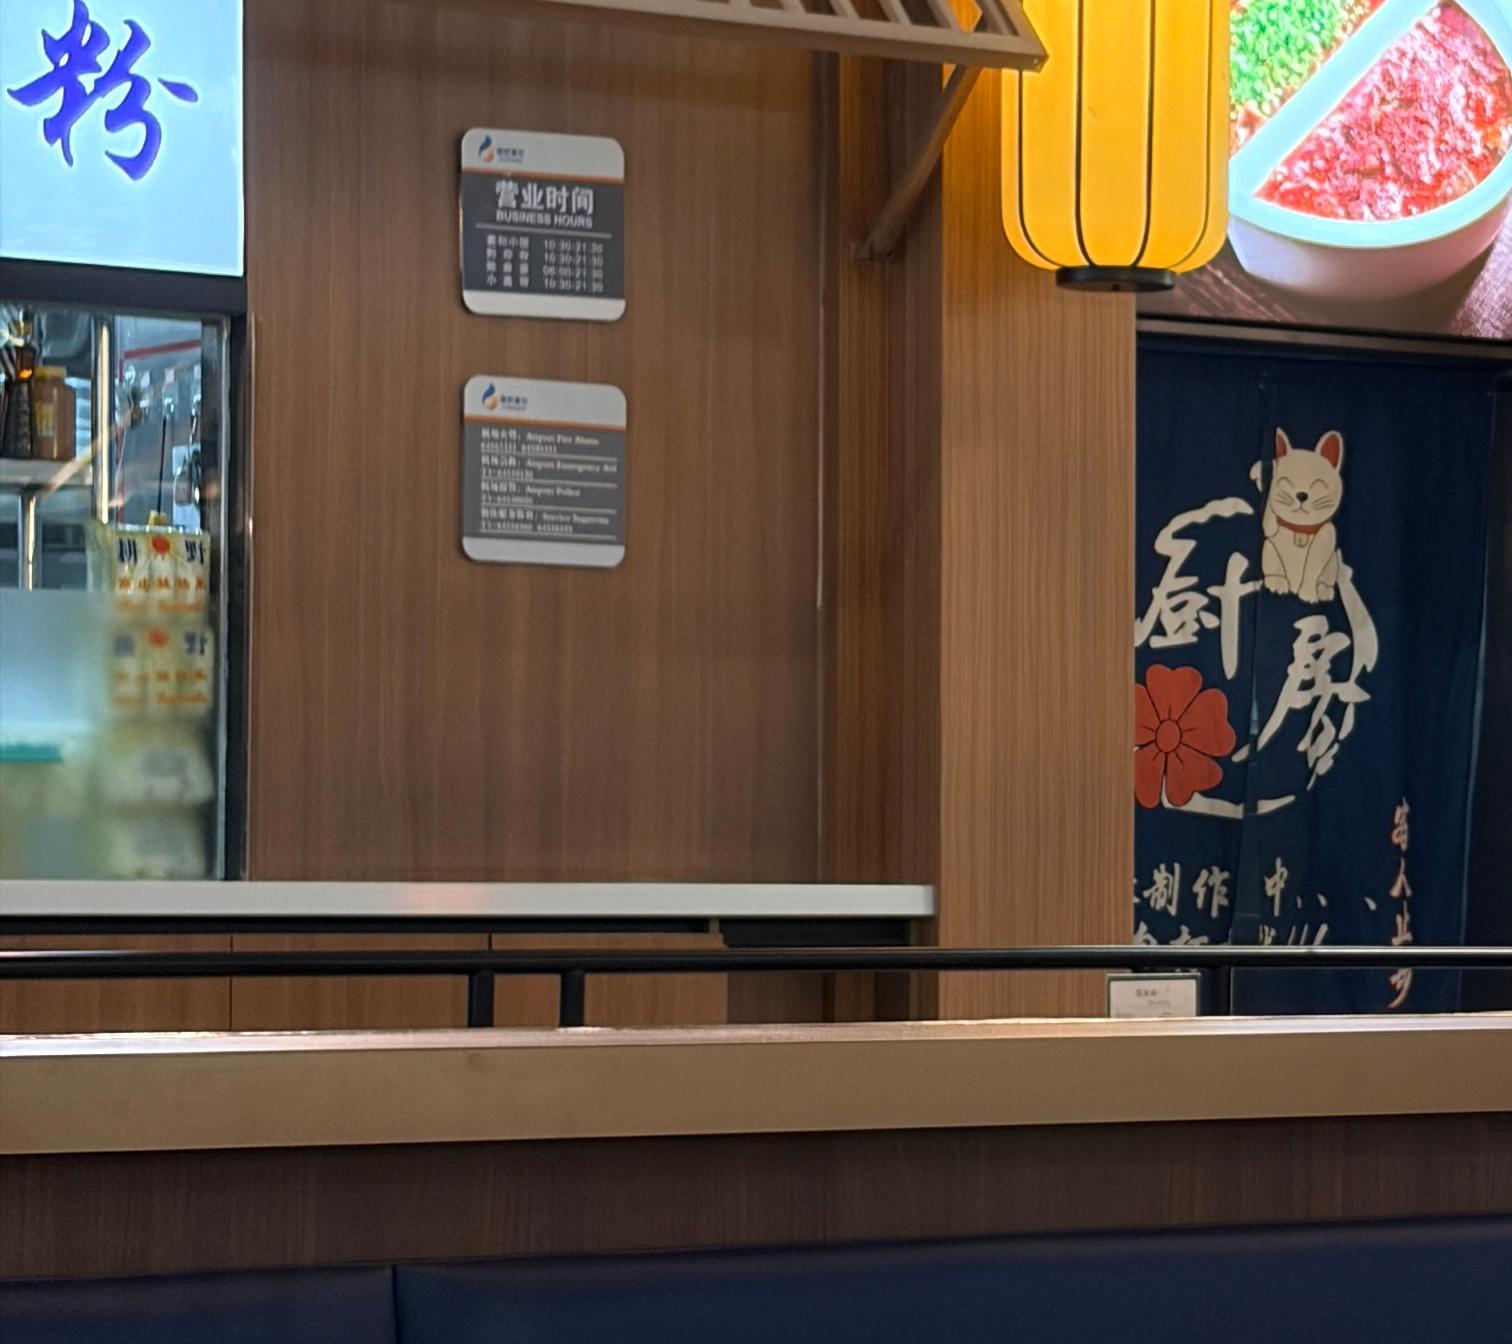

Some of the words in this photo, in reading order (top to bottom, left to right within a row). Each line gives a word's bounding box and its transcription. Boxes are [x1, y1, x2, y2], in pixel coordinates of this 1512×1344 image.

[495, 180, 594, 215] 营业时间
[496, 209, 551, 225] BUSINESS
[554, 213, 593, 229] HOURS
